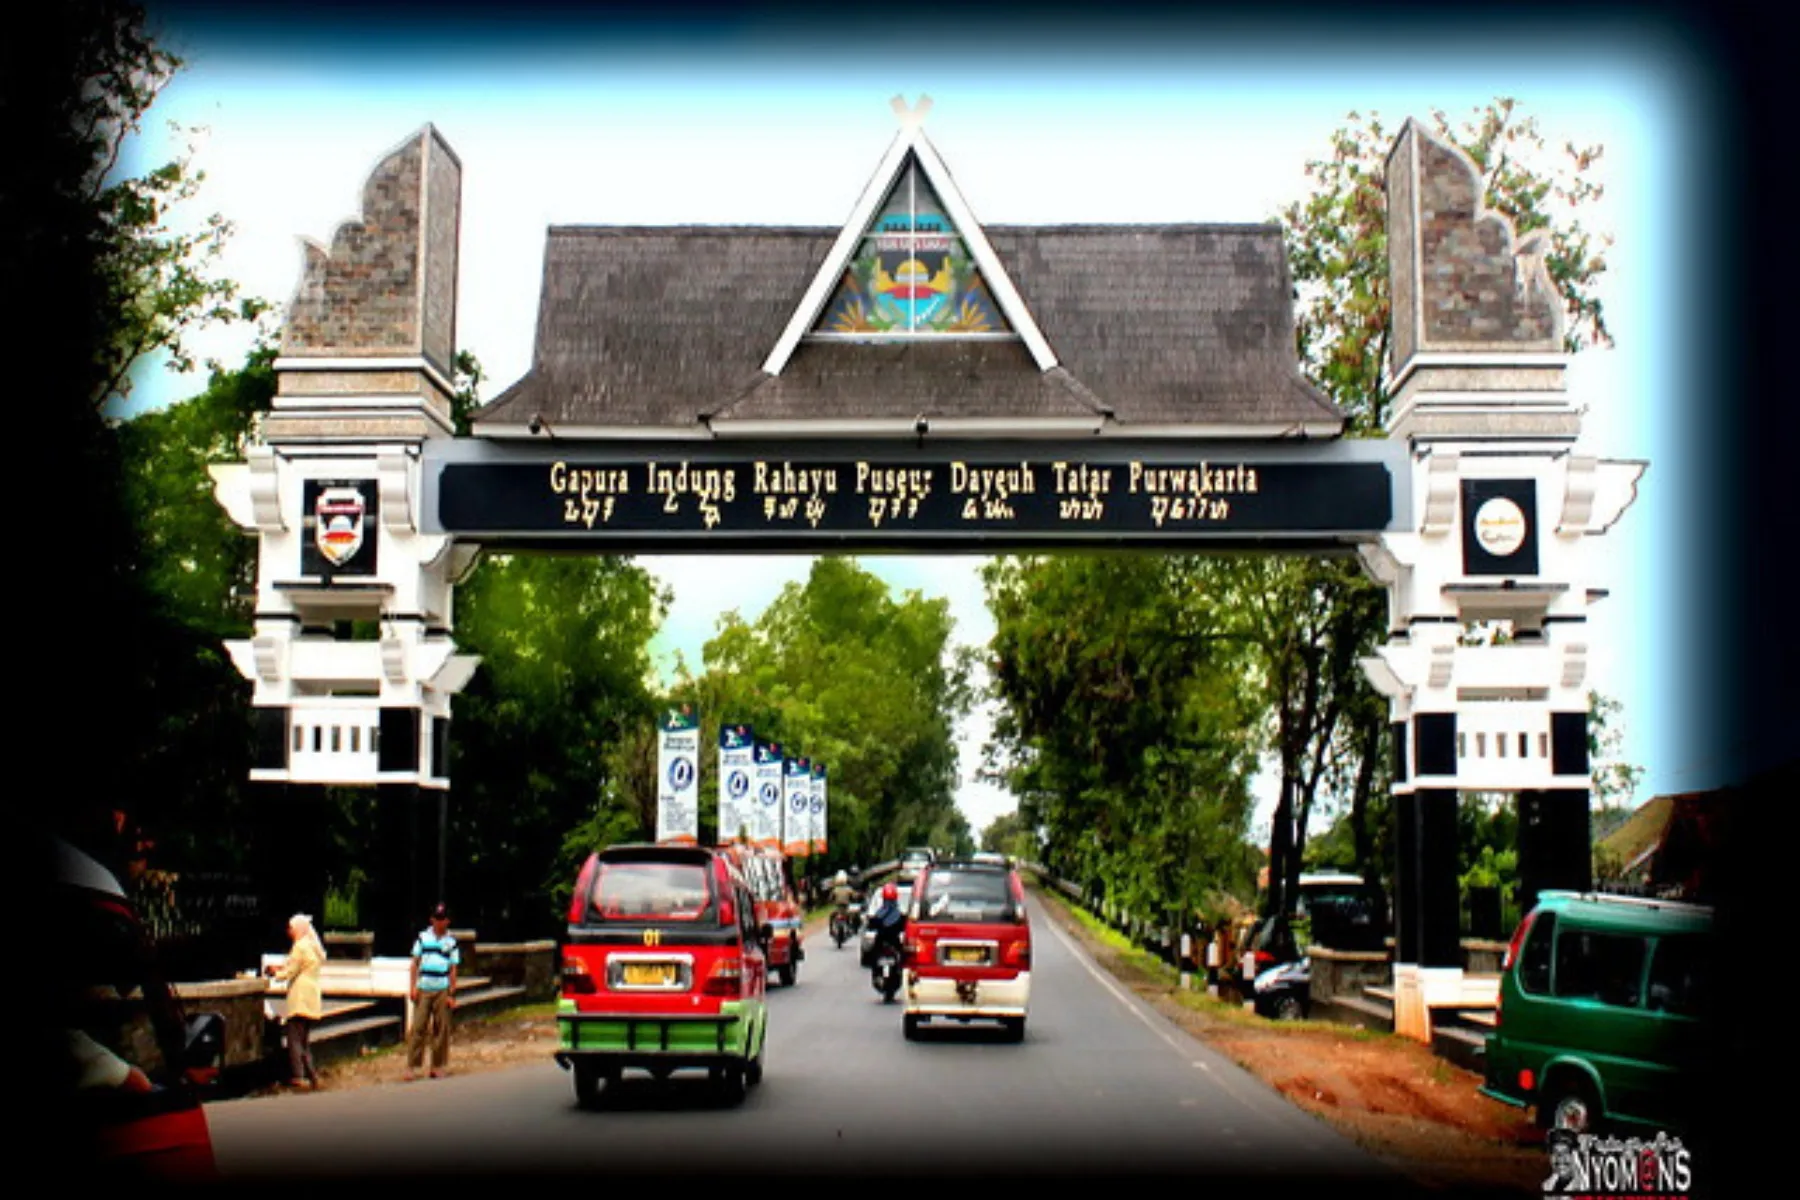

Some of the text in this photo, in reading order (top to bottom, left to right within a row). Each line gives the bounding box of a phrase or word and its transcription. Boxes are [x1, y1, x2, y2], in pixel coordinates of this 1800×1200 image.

[550, 460, 1258, 502] Gapura Indung Rahayu Puseur Dayeuh Tatar Purwakarta
[643, 928, 661, 947] 01
